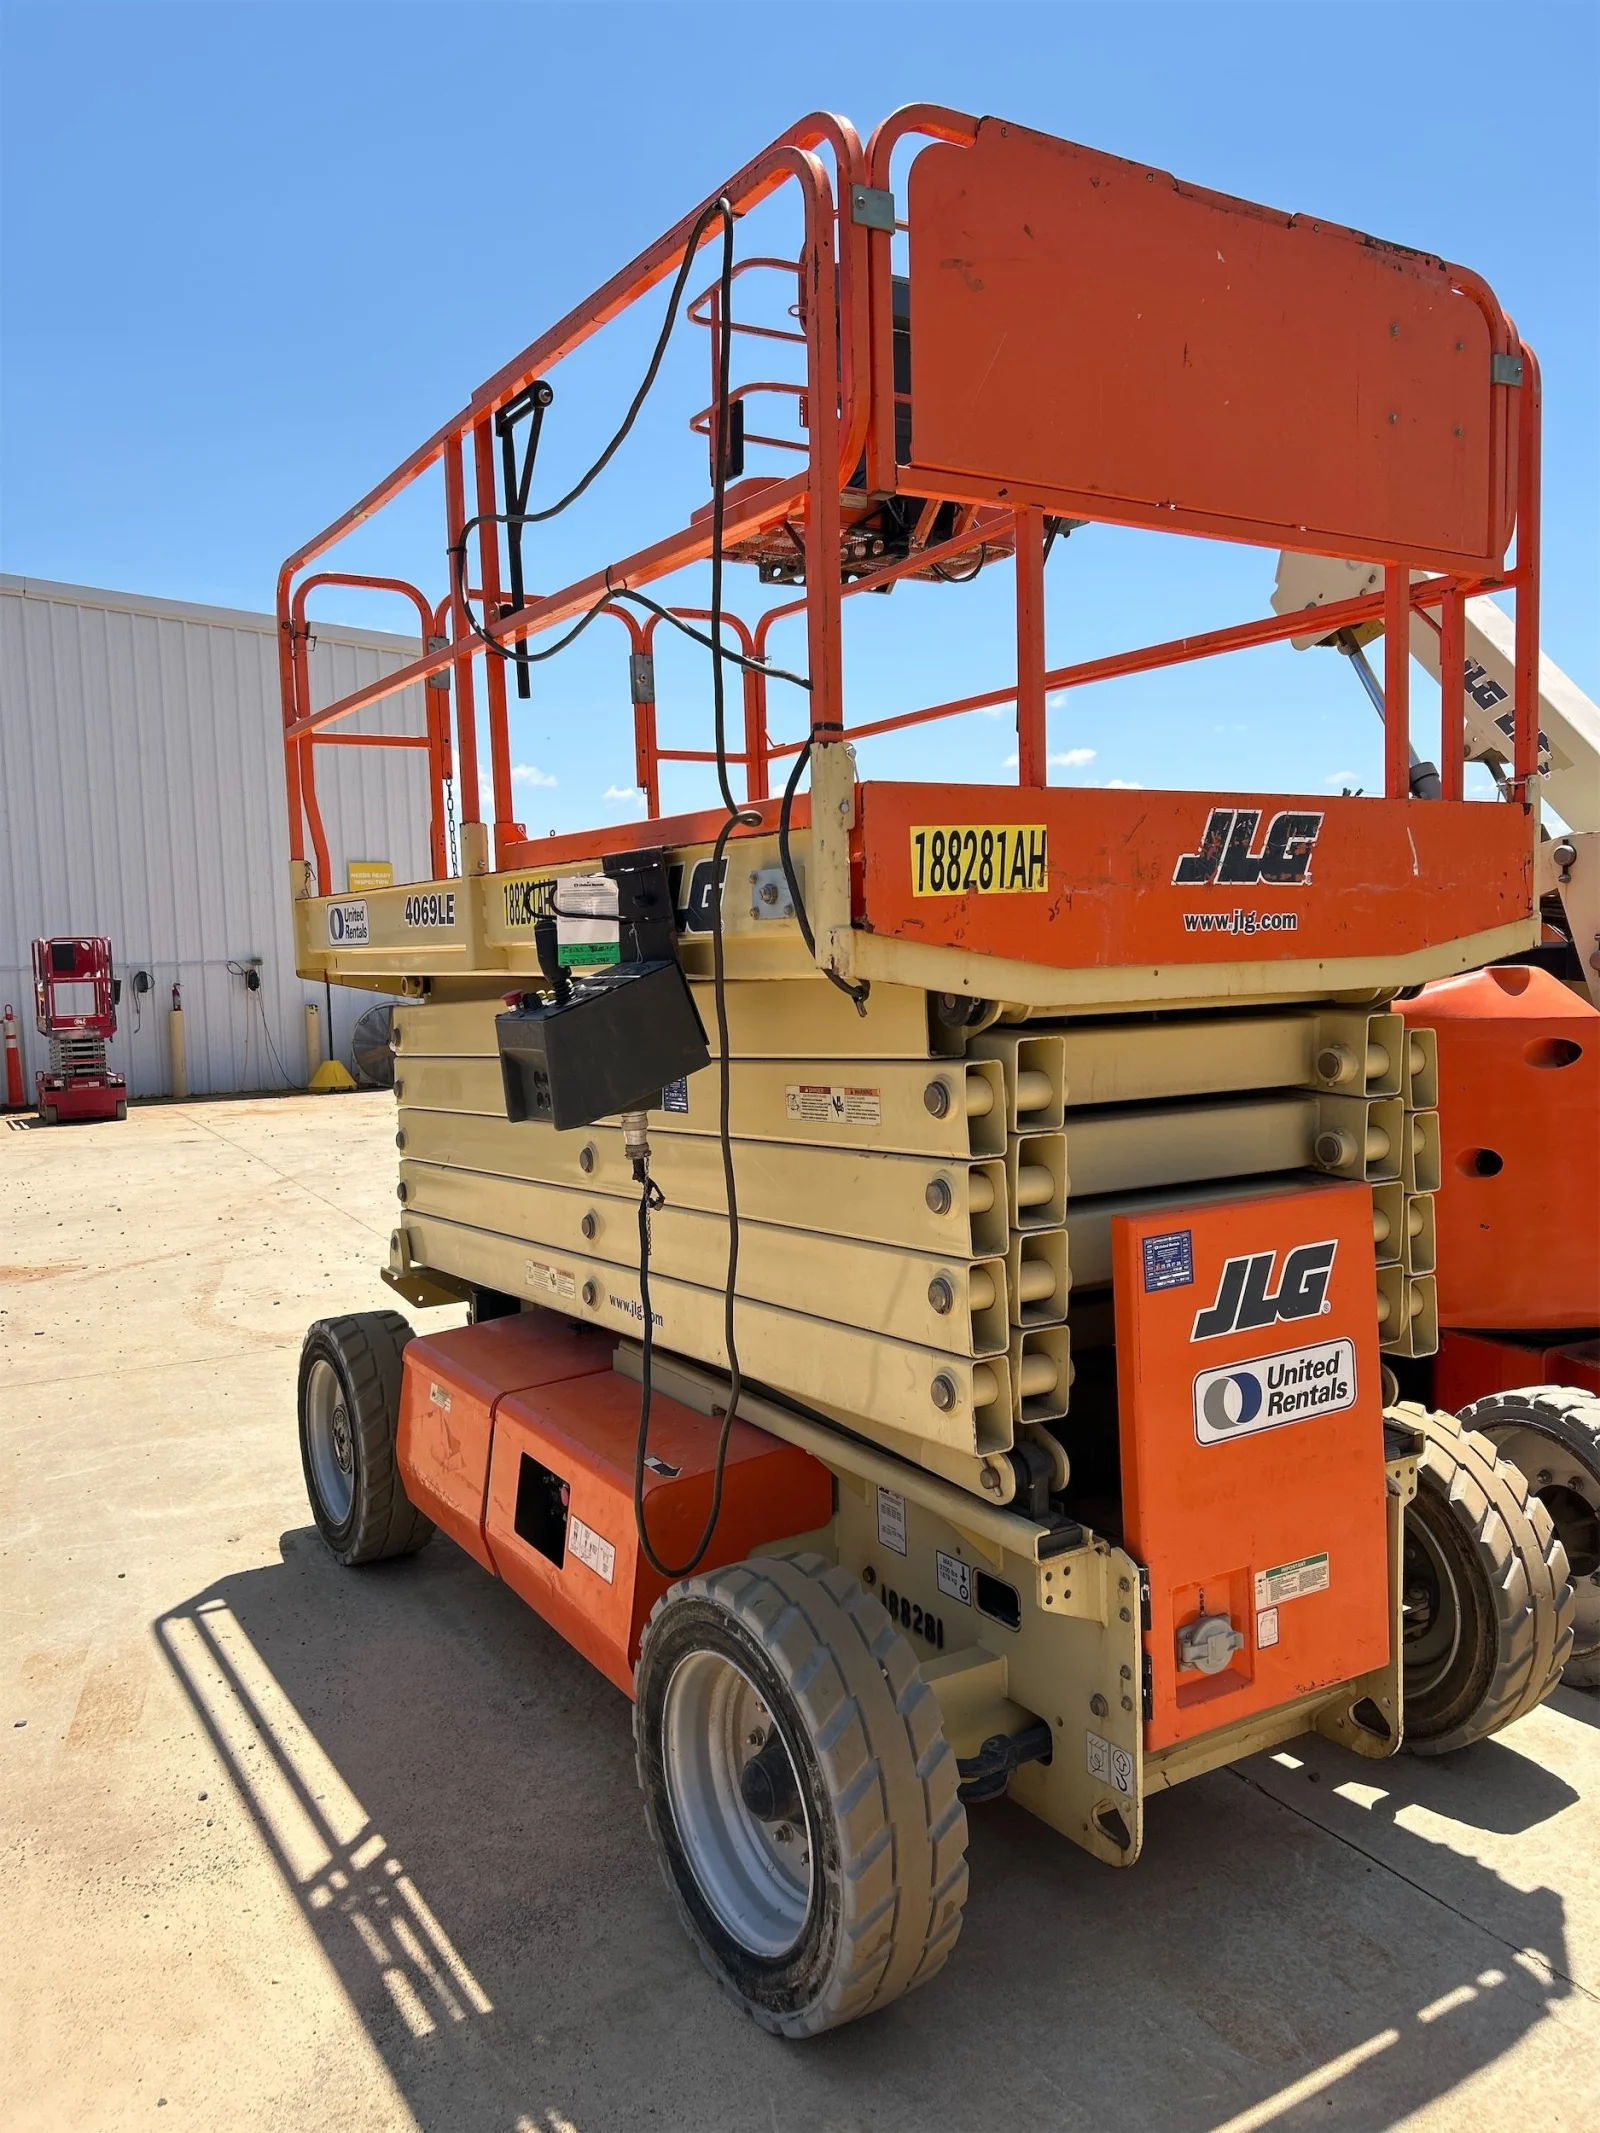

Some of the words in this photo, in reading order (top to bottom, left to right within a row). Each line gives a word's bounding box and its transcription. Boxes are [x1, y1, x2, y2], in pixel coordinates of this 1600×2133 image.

[914, 830, 1046, 892] 188281AH
[1172, 808, 1324, 885] JLG
[344, 906, 364, 923] United
[405, 893, 456, 926] 4069LE
[1183, 908, 1297, 935] www.jlg.com
[345, 922, 368, 940] Rentals
[1189, 1239, 1339, 1343] JLG
[609, 1294, 664, 1328] www.jlg.om
[1267, 1350, 1341, 1390] United
[1267, 1377, 1349, 1418] Rentals
